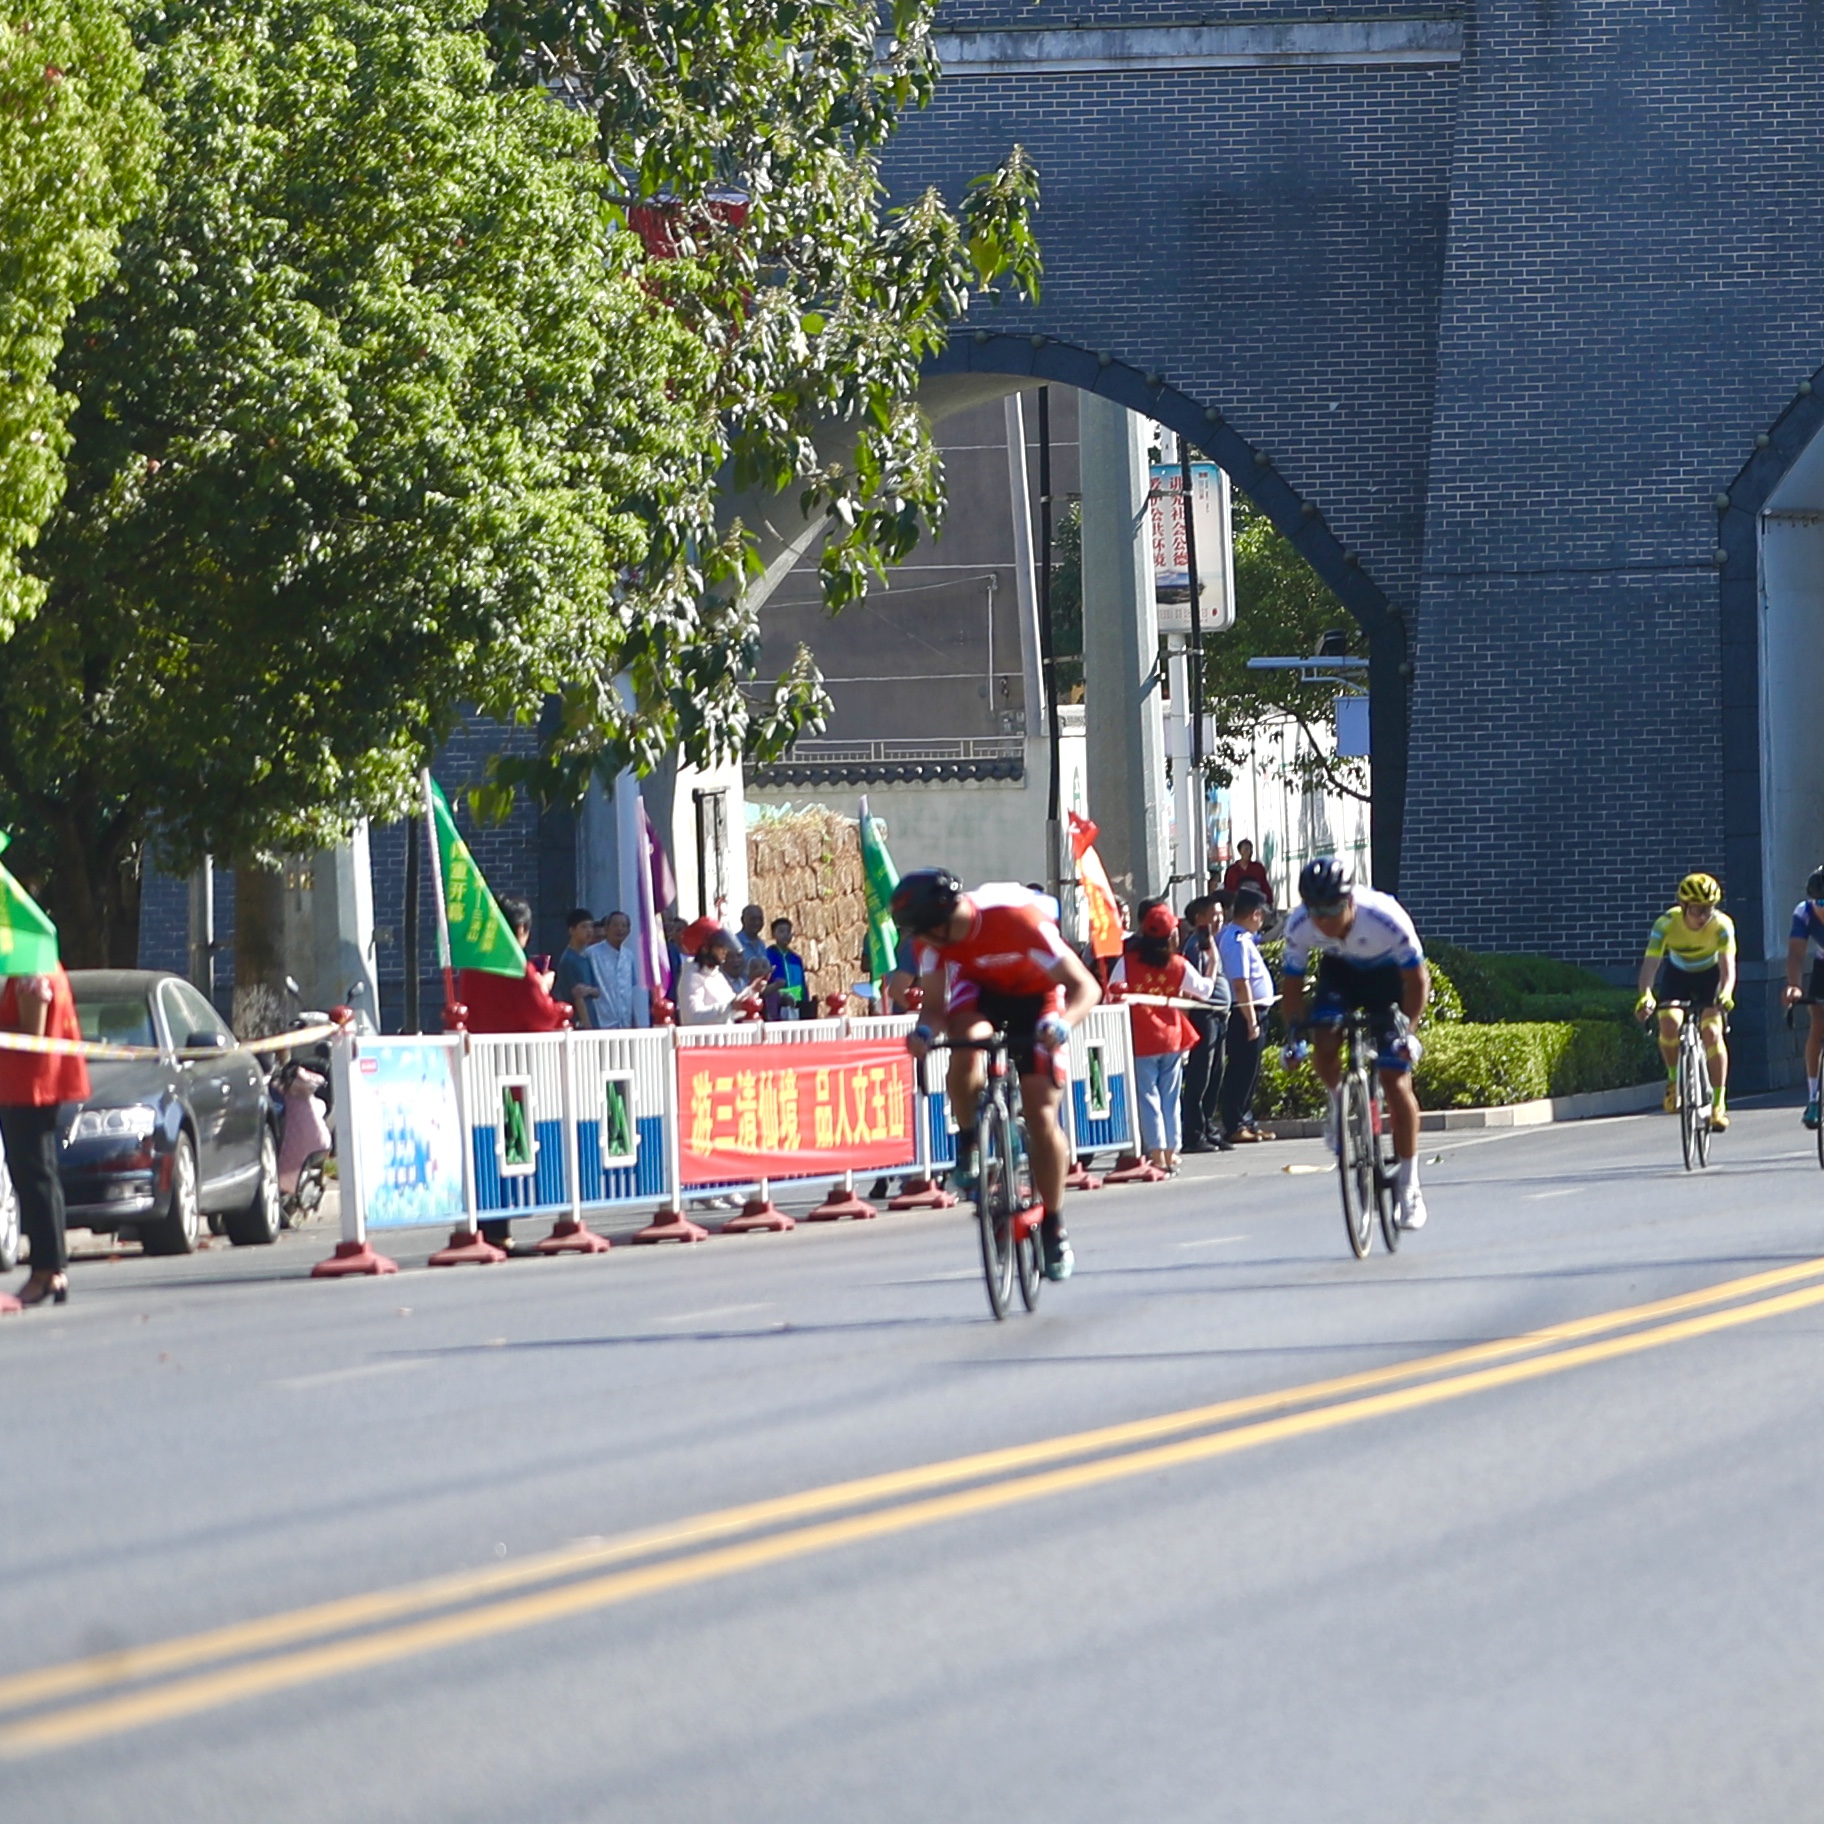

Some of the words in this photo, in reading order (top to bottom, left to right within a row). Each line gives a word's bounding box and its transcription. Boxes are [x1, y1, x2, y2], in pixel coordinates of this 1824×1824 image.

[690, 1067, 802, 1156] 游三清仙境
[814, 1063, 906, 1148] 品人文玉山
